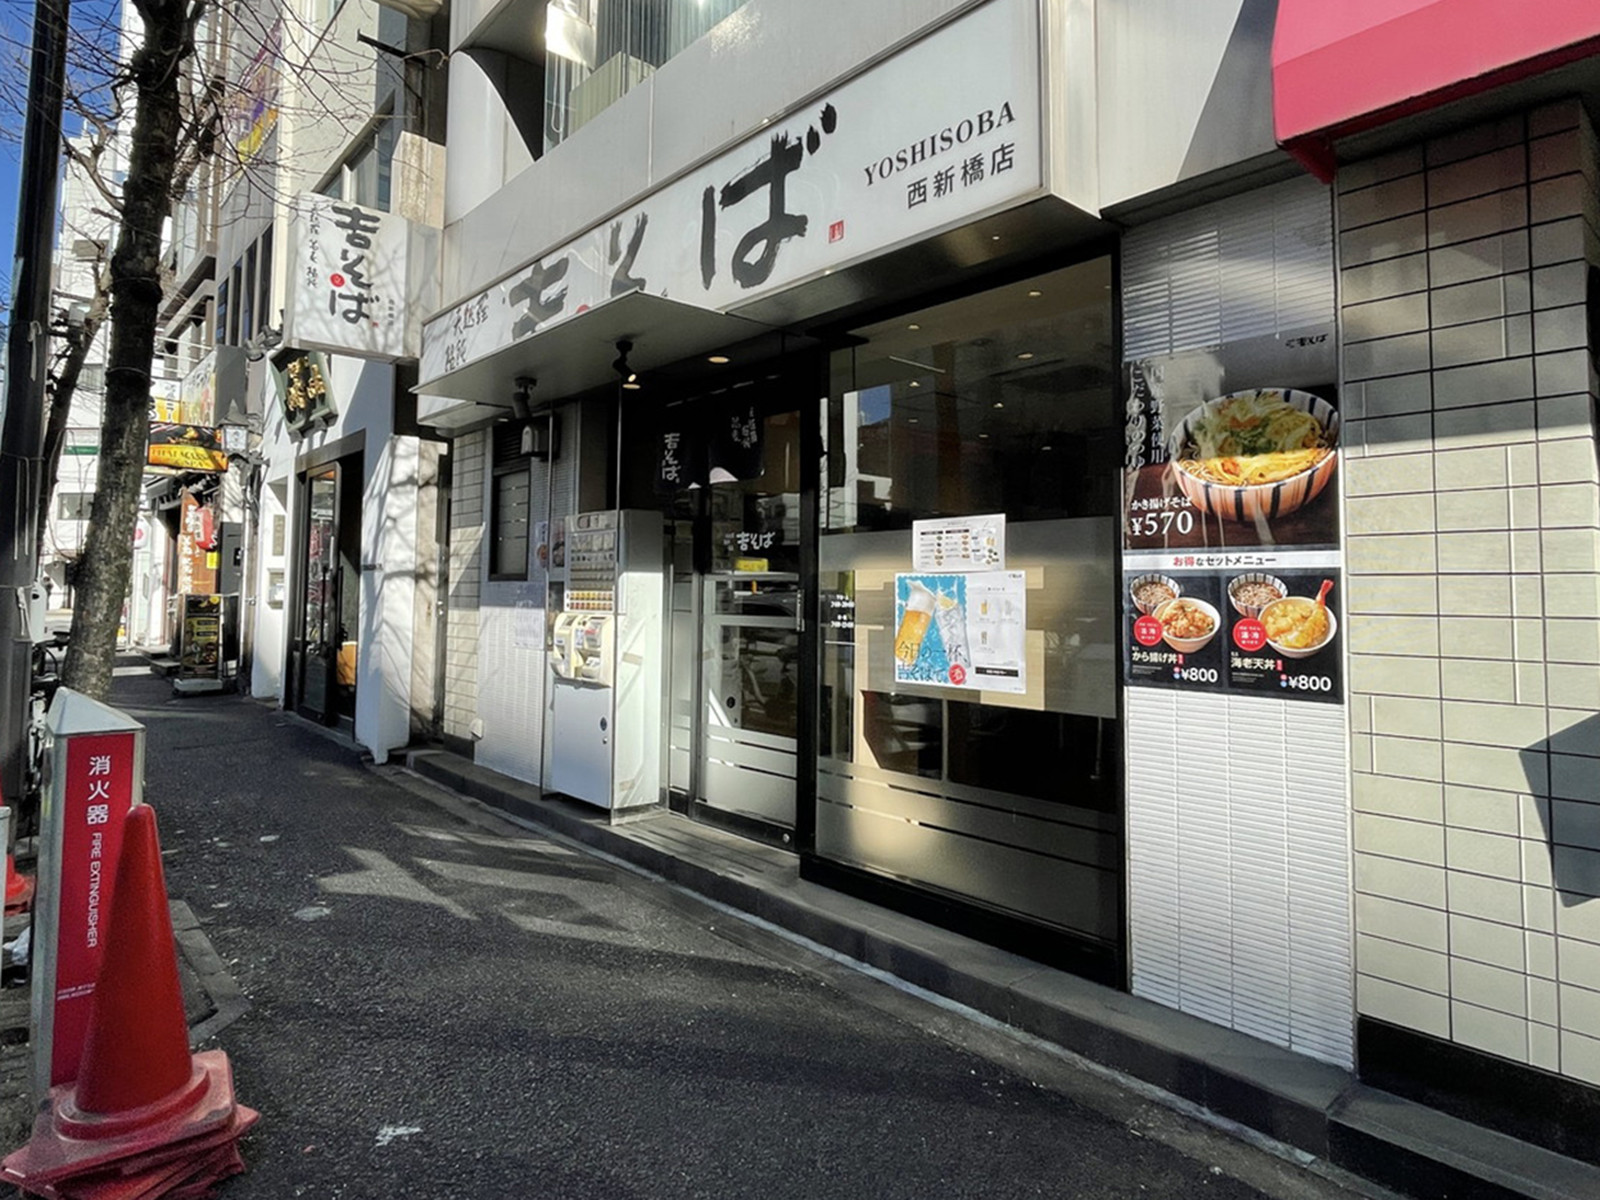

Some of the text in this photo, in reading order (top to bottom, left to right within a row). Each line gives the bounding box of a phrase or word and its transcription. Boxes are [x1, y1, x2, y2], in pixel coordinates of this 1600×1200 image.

[863, 101, 1016, 188] YOSHISOBA
[906, 143, 1016, 210] 西新橋店
[328, 205, 381, 325] 吉そば
[1131, 496, 1192, 510] かき揚げそば
[1131, 510, 1193, 536] ¥570
[736, 531, 776, 551] 吉そば
[1173, 556, 1277, 567] お得なセットメニュー
[1132, 651, 1178, 664] から揚げ丼
[1230, 656, 1275, 671] 海老天丼
[1181, 667, 1218, 683] ¥800
[1288, 674, 1332, 692] ¥800
[87, 754, 111, 825] 消火器
[87, 832, 103, 948] FIRE EXTINGUISHER
